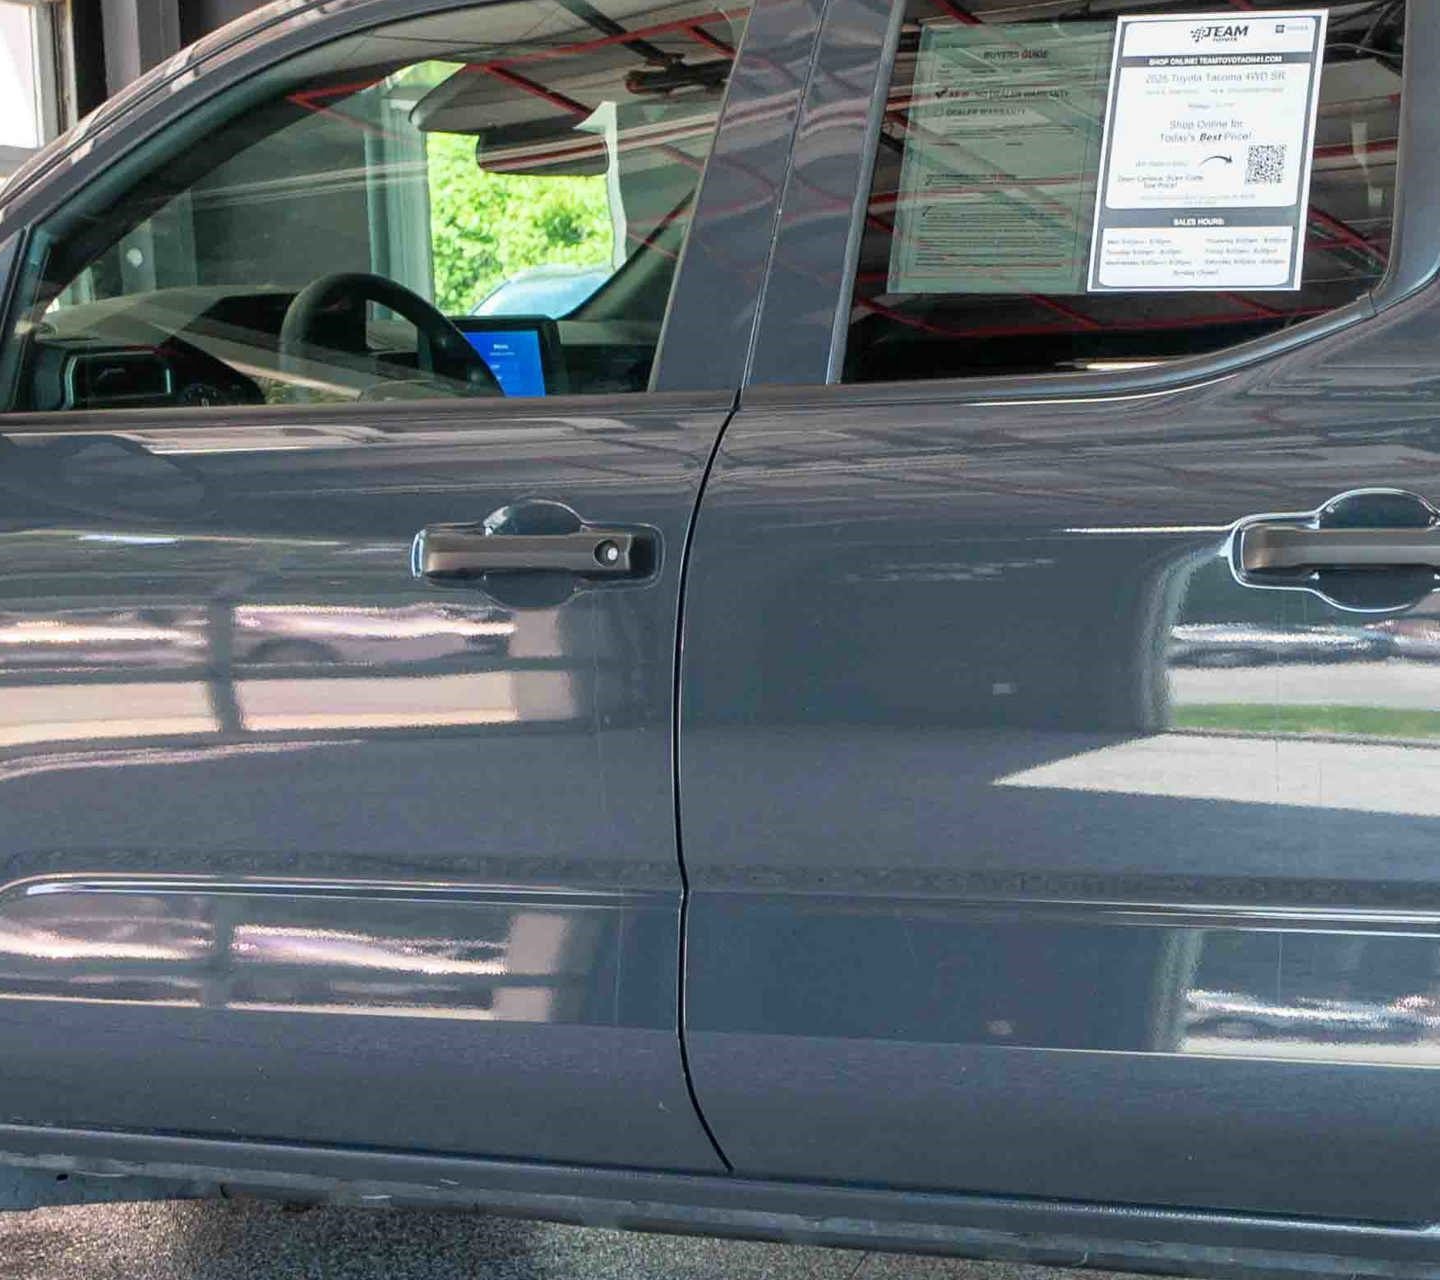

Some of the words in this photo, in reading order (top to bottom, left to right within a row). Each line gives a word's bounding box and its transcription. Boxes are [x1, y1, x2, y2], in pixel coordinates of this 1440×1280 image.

[1205, 25, 1249, 37] TEAM
[1148, 58, 1169, 66] SHOP
[1171, 72, 1202, 85] Toyota
[1206, 72, 1242, 82] Tacoma
[1169, 120, 1195, 130] Shop
[1196, 120, 1228, 129] Online
[1230, 119, 1244, 128] for
[1199, 133, 1223, 142] Best
[1173, 218, 1197, 226] SALES
